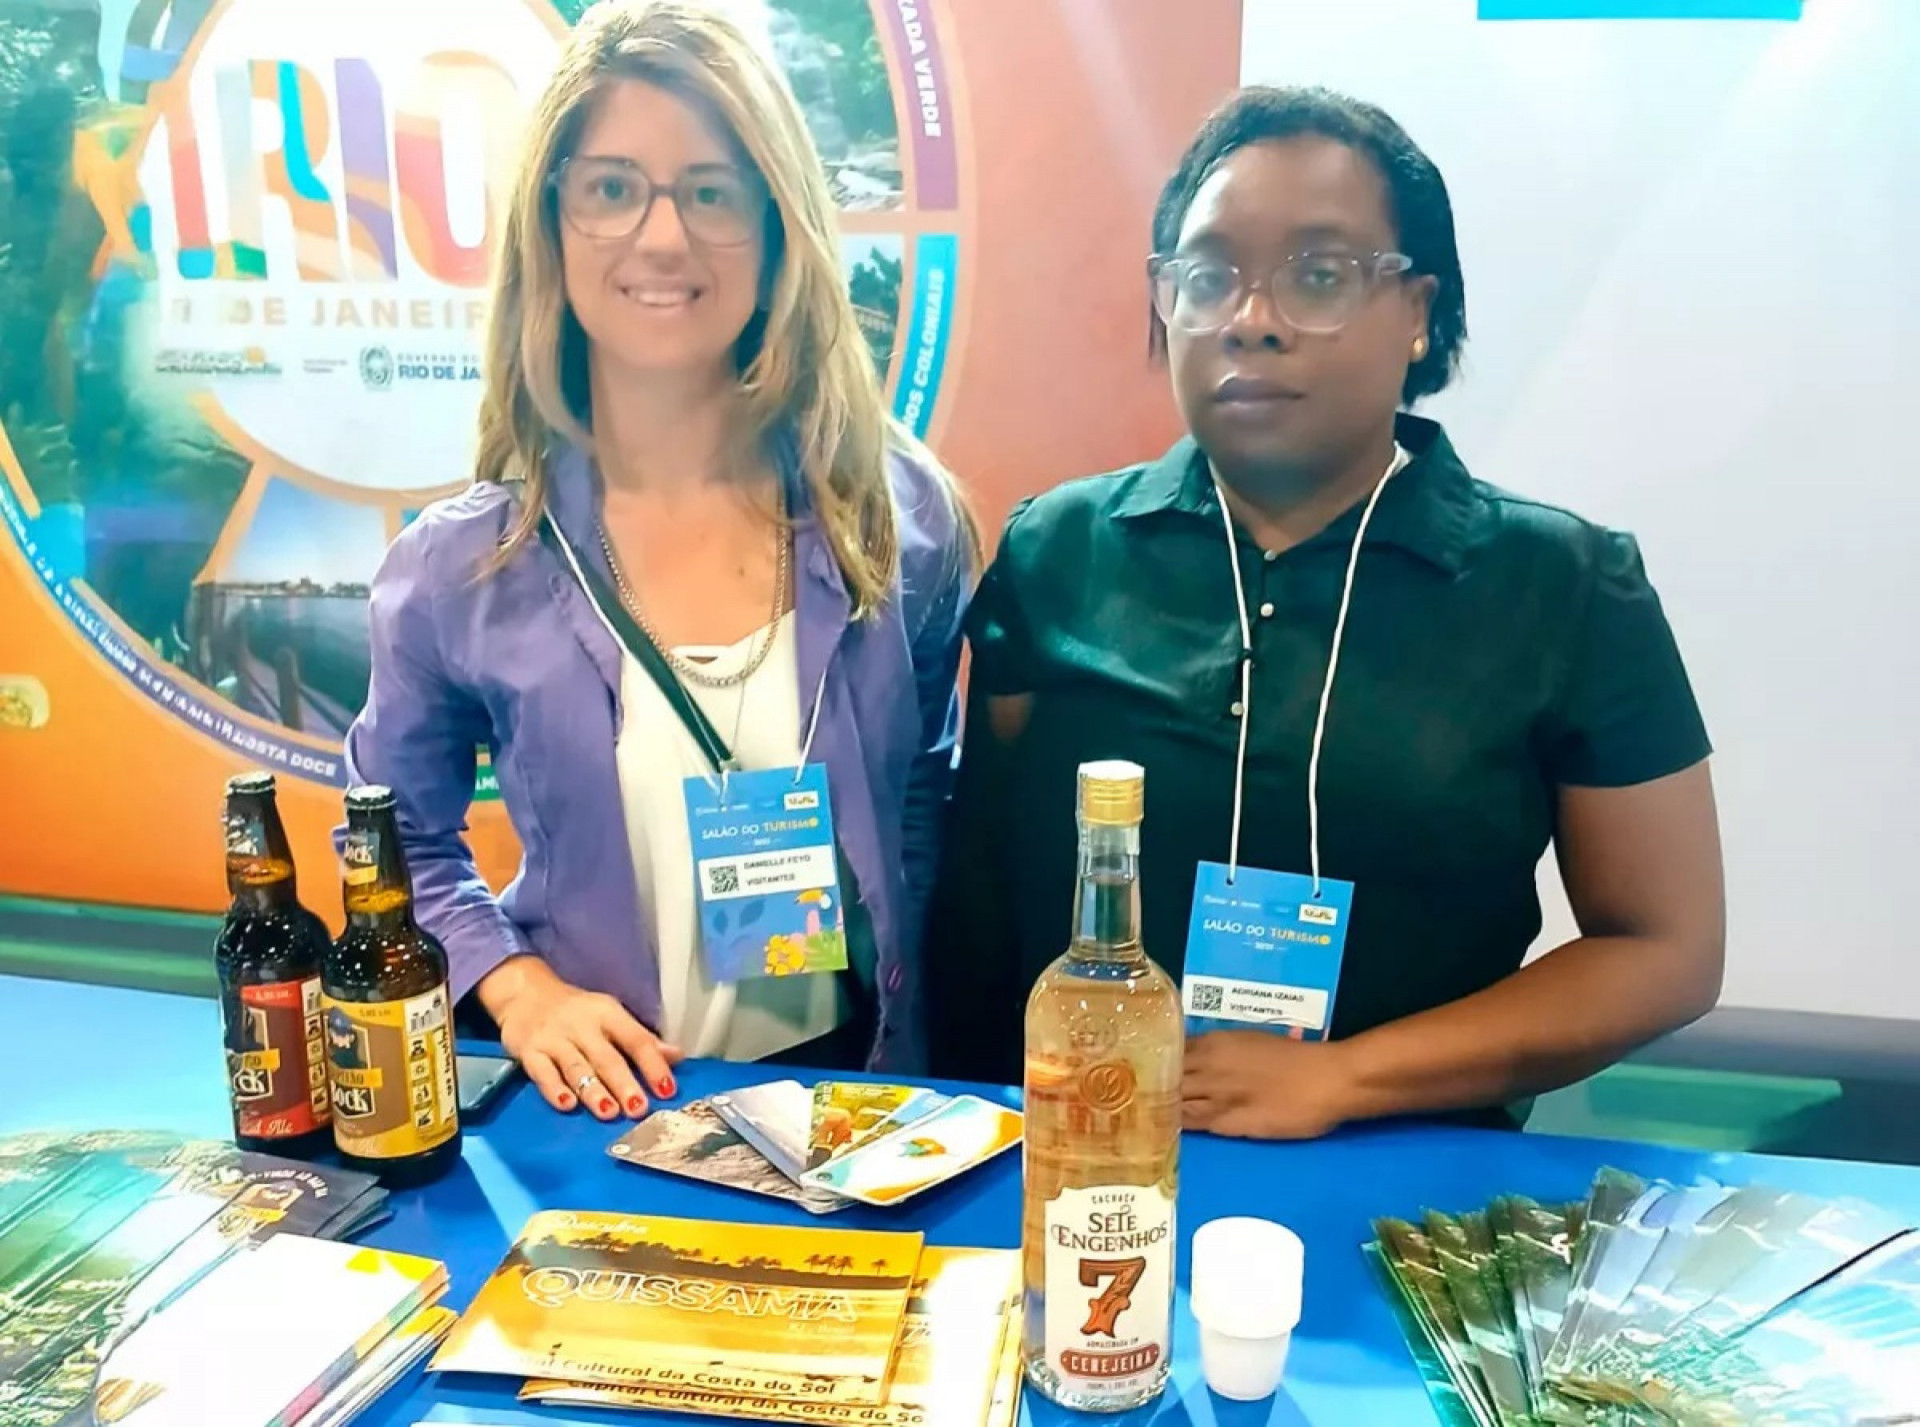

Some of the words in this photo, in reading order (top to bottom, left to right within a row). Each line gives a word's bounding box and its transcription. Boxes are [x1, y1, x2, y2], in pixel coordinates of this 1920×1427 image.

[913, 57, 942, 137] VERDE
[398, 364, 429, 379] RIO
[432, 365, 456, 380] DE
[290, 752, 336, 778] DOCE
[702, 825, 738, 839] SALÃO
[742, 824, 759, 835] DO
[763, 817, 819, 832] TURISMO
[1203, 918, 1243, 933] SALÃO
[1246, 925, 1265, 937] DO
[1270, 928, 1331, 945] TURISMO
[1051, 1221, 1168, 1251] ENGENHOS
[1079, 1256, 1146, 1338] 7
[1071, 1351, 1153, 1374] CEREJEIRA
[563, 1360, 652, 1378] Cultural
[658, 1367, 685, 1381] da
[694, 1372, 756, 1388] Costa
[764, 1380, 792, 1391] do
[800, 1382, 836, 1394] Sol
[654, 1387, 745, 1406] Cultural
[751, 1396, 778, 1409] da
[788, 1400, 851, 1416] Costa
[860, 1409, 889, 1420] do
